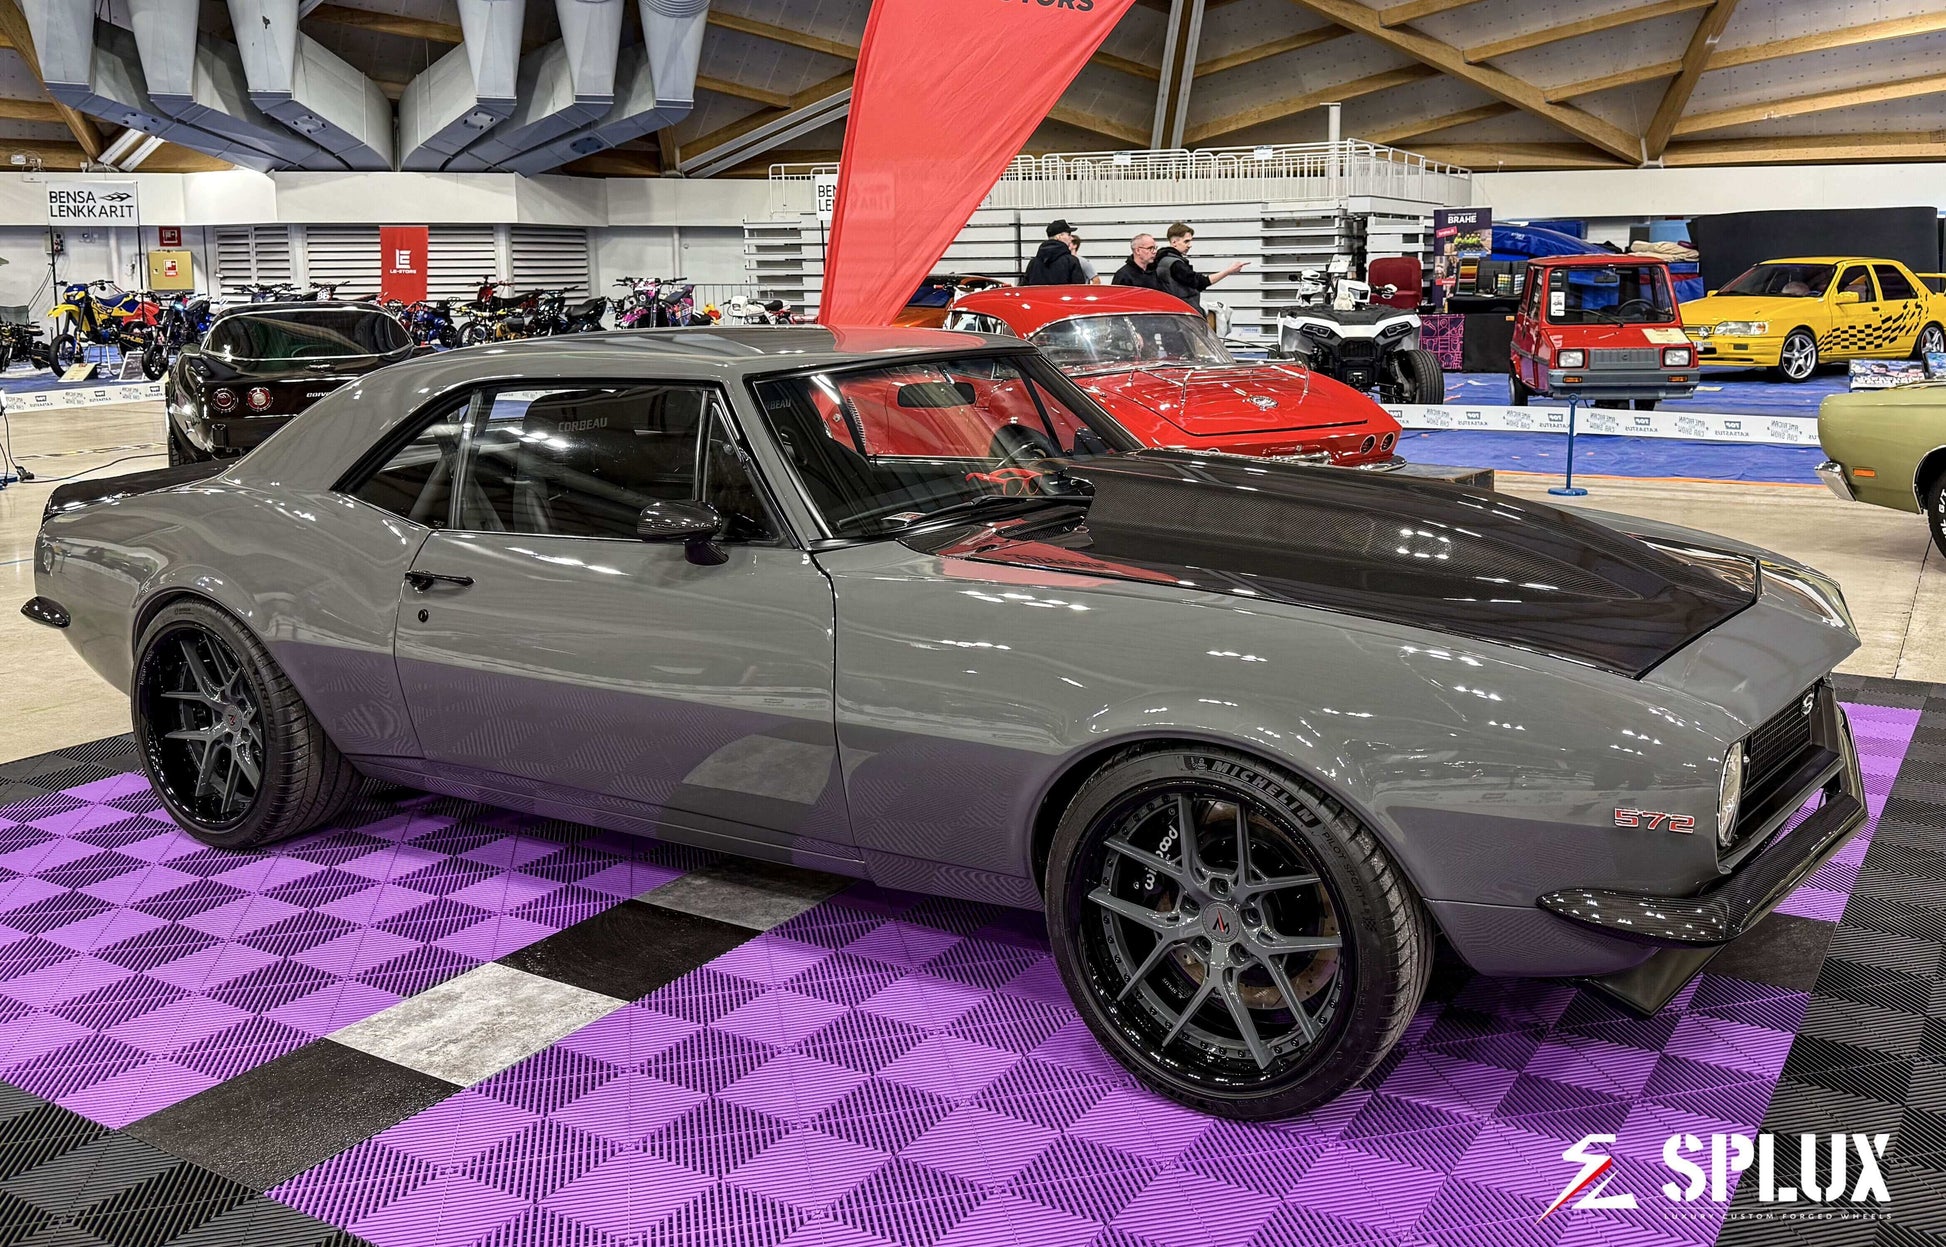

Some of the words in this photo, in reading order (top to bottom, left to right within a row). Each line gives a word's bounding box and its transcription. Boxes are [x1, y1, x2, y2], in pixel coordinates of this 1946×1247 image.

[49, 190, 97, 204] BENSA
[50, 205, 134, 218] LENKKARIT
[1447, 215, 1477, 224] BRAHE
[558, 417, 608, 433] CORBEAU
[1211, 760, 1316, 823] MICHELIN
[1614, 807, 1695, 834] 572
[1321, 831, 1347, 860] PILOT
